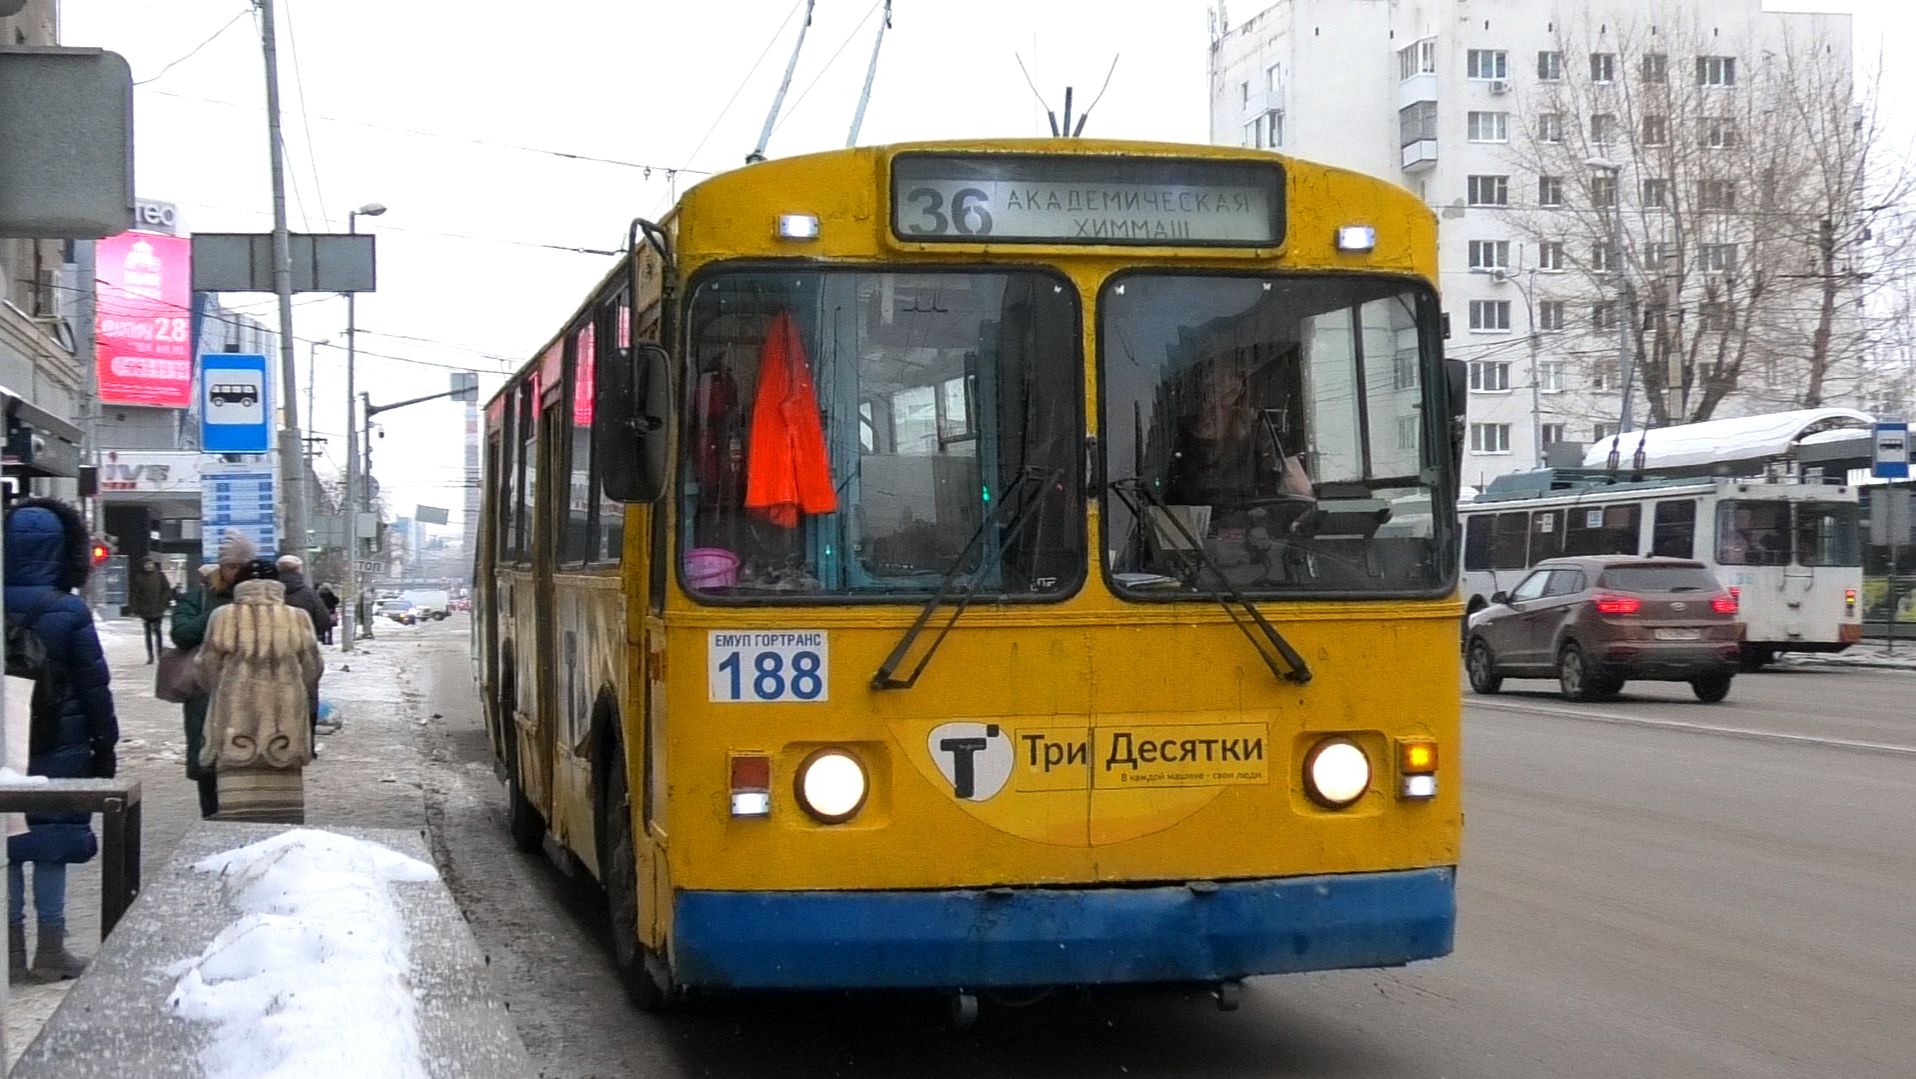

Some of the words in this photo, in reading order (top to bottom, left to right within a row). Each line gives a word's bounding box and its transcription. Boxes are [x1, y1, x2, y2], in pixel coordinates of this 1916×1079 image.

[906, 188, 993, 236] 36
[1007, 189, 1250, 213] АКАДЕМИЧЕСКАЯ
[1073, 217, 1190, 239] ХИММАШ
[715, 635, 751, 647] ЕМУП
[755, 634, 821, 647] ГОРТРАНС
[719, 651, 822, 700] 188
[1021, 734, 1087, 772] Три
[1106, 733, 1263, 771] Десятки
